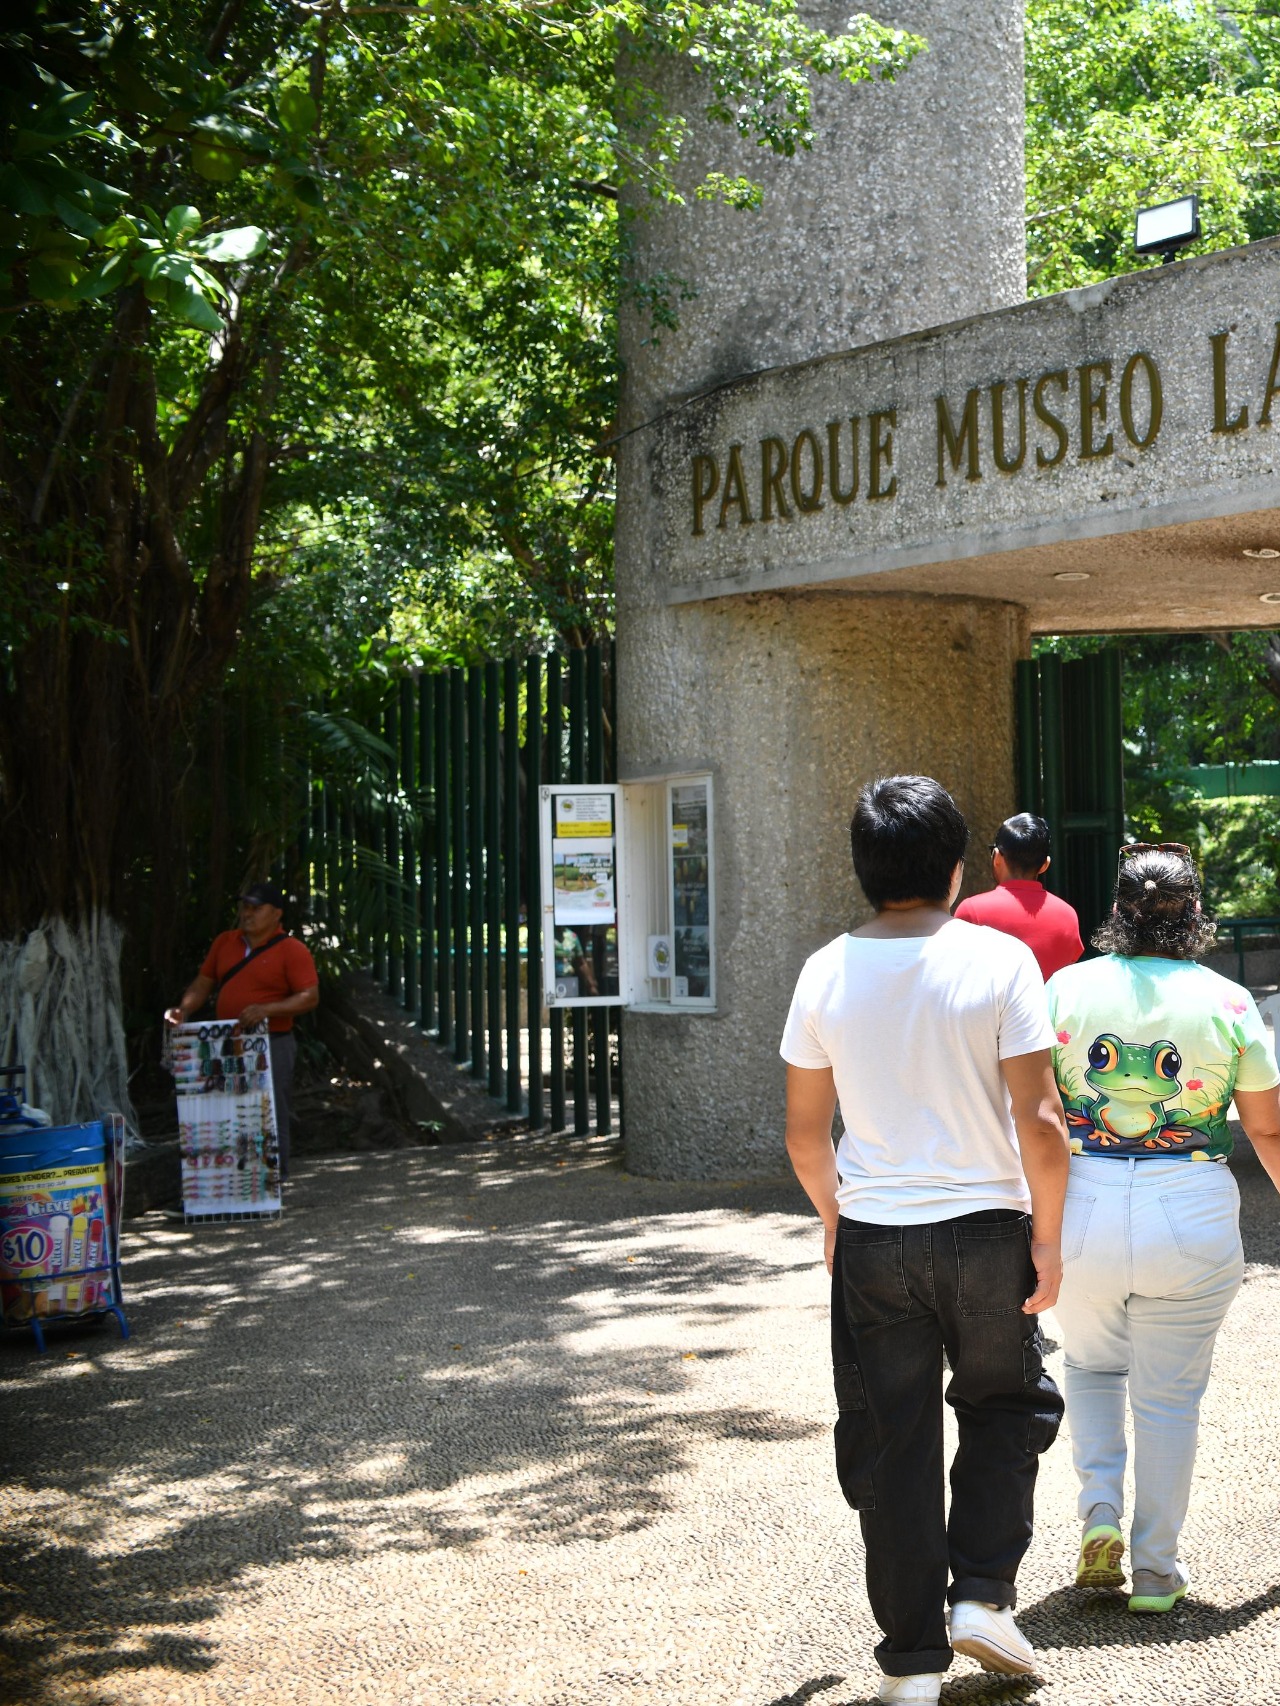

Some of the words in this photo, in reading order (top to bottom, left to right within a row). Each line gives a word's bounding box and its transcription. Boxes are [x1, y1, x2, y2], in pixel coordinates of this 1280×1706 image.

[691, 408, 898, 536] PARQUE
[934, 351, 1163, 487] MUSEO
[3, 1229, 44, 1262] $10
